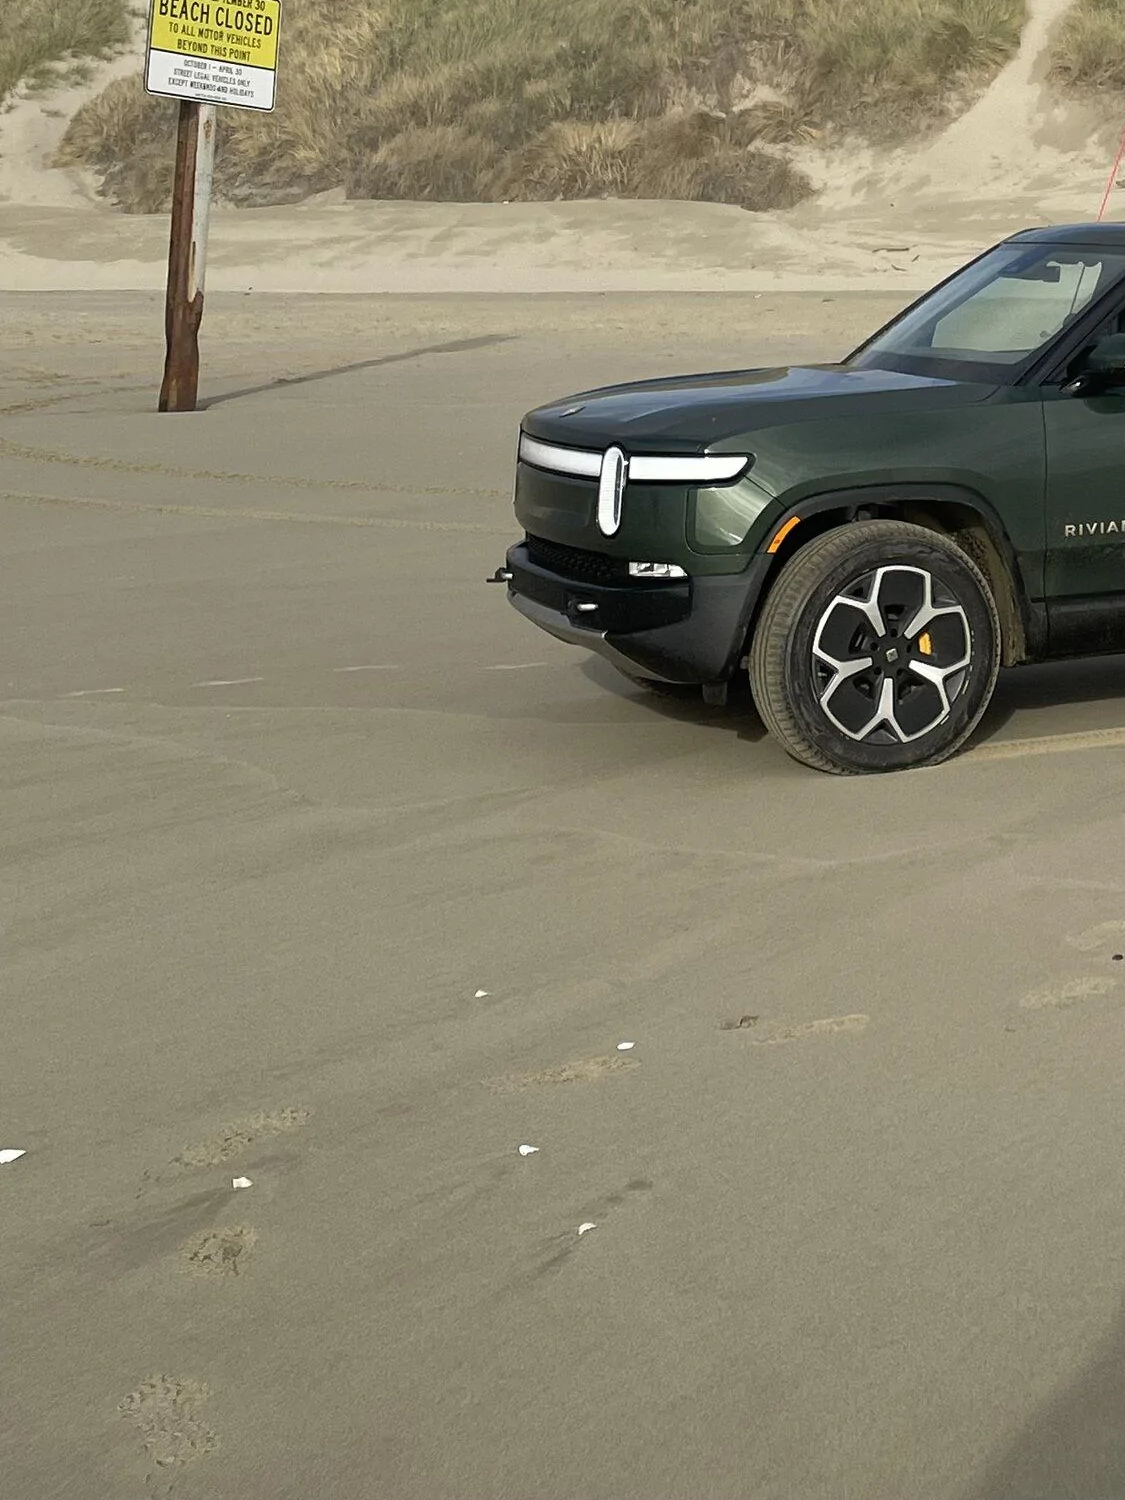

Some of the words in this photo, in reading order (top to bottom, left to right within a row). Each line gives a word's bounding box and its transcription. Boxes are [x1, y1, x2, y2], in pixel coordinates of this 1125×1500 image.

[255, 0, 265, 11] 30
[216, 7, 272, 36] CLOSED
[169, 22, 178, 33] TO
[181, 26, 195, 37] ALL
[198, 29, 223, 41] MOTOR
[227, 34, 261, 48] VEHICLES
[178, 39, 207, 54] BEYOND
[211, 45, 227, 58] THIS
[229, 48, 250, 62] POINT
[174, 68, 192, 77] STREET
[195, 71, 209, 80] LEGAL
[212, 74, 236, 85] VEHICLES
[184, 59, 207, 69] OCTOBER
[219, 65, 233, 75] APRIL
[168, 77, 187, 87] EXCEPT
[229, 88, 254, 98] HOLIDAYS
